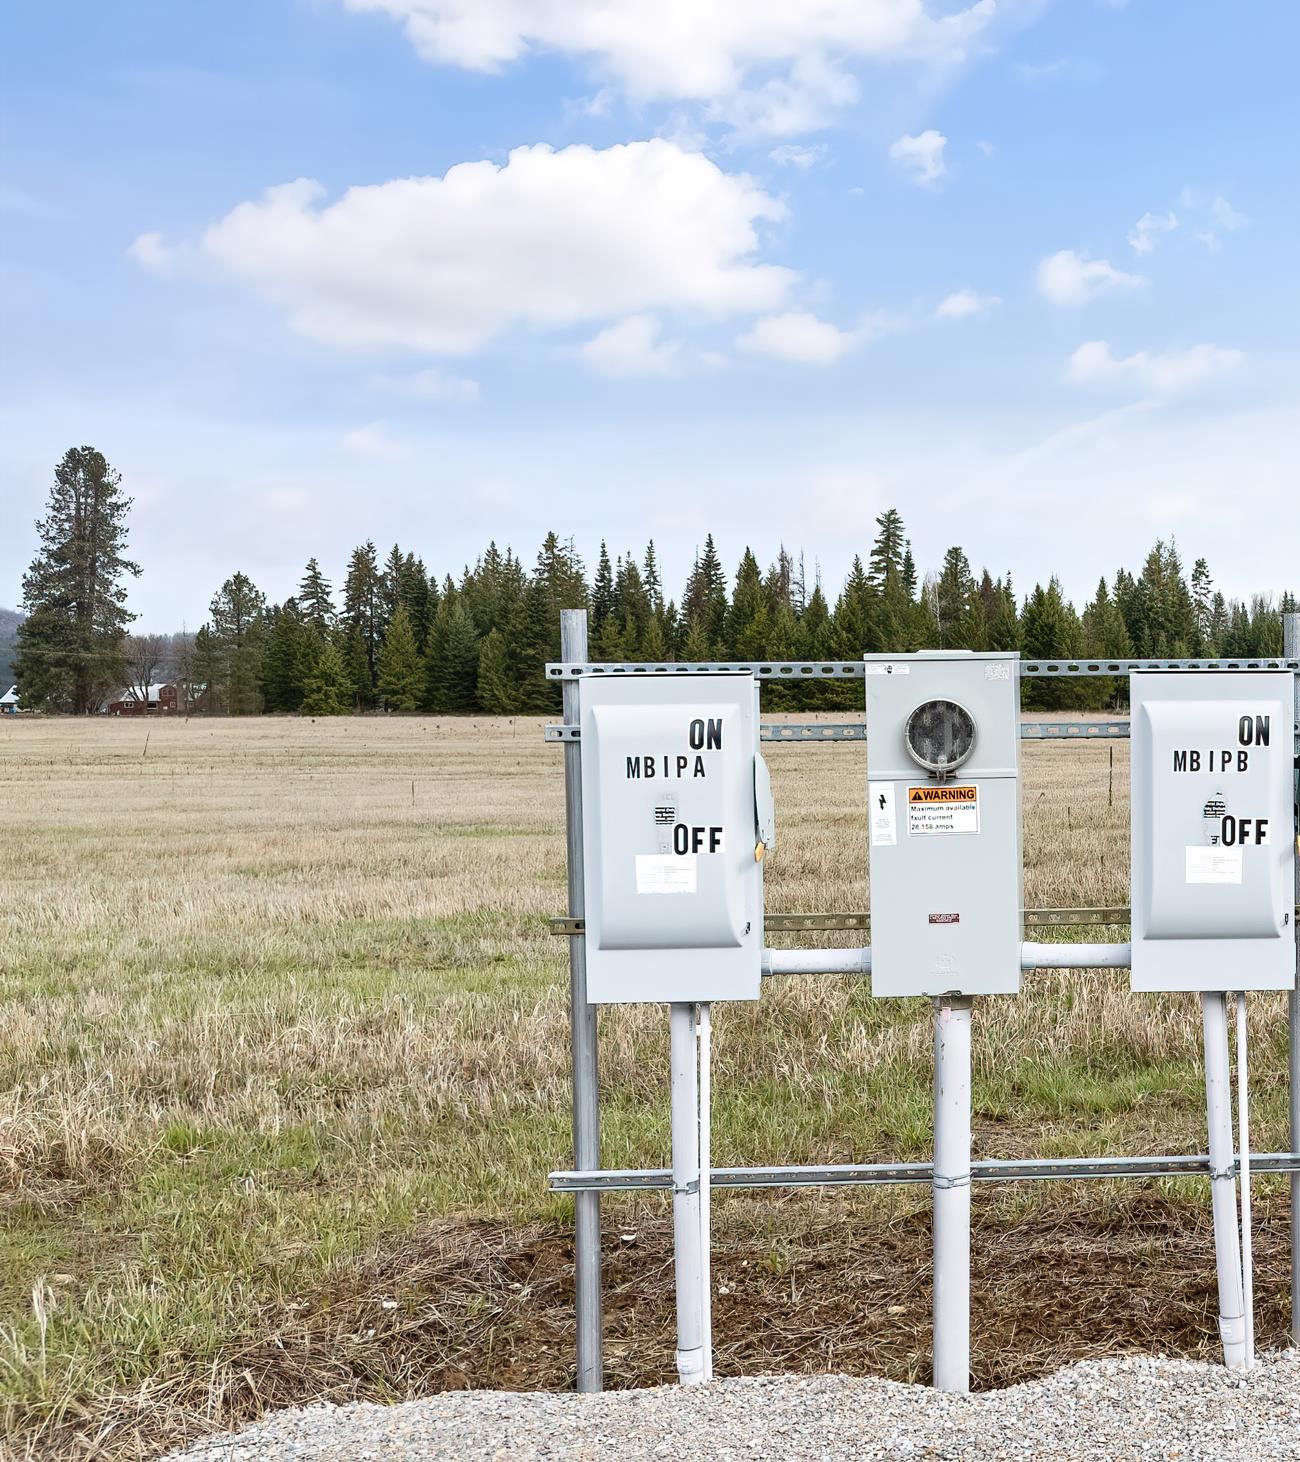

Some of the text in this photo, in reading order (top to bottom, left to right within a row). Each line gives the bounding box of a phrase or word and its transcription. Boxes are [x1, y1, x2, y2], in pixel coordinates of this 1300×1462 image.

[690, 719, 722, 750] ON
[1239, 716, 1269, 746] ON
[923, 789, 974, 800] WARNING
[674, 824, 722, 855] OFF
[1222, 815, 1268, 846] OFF
